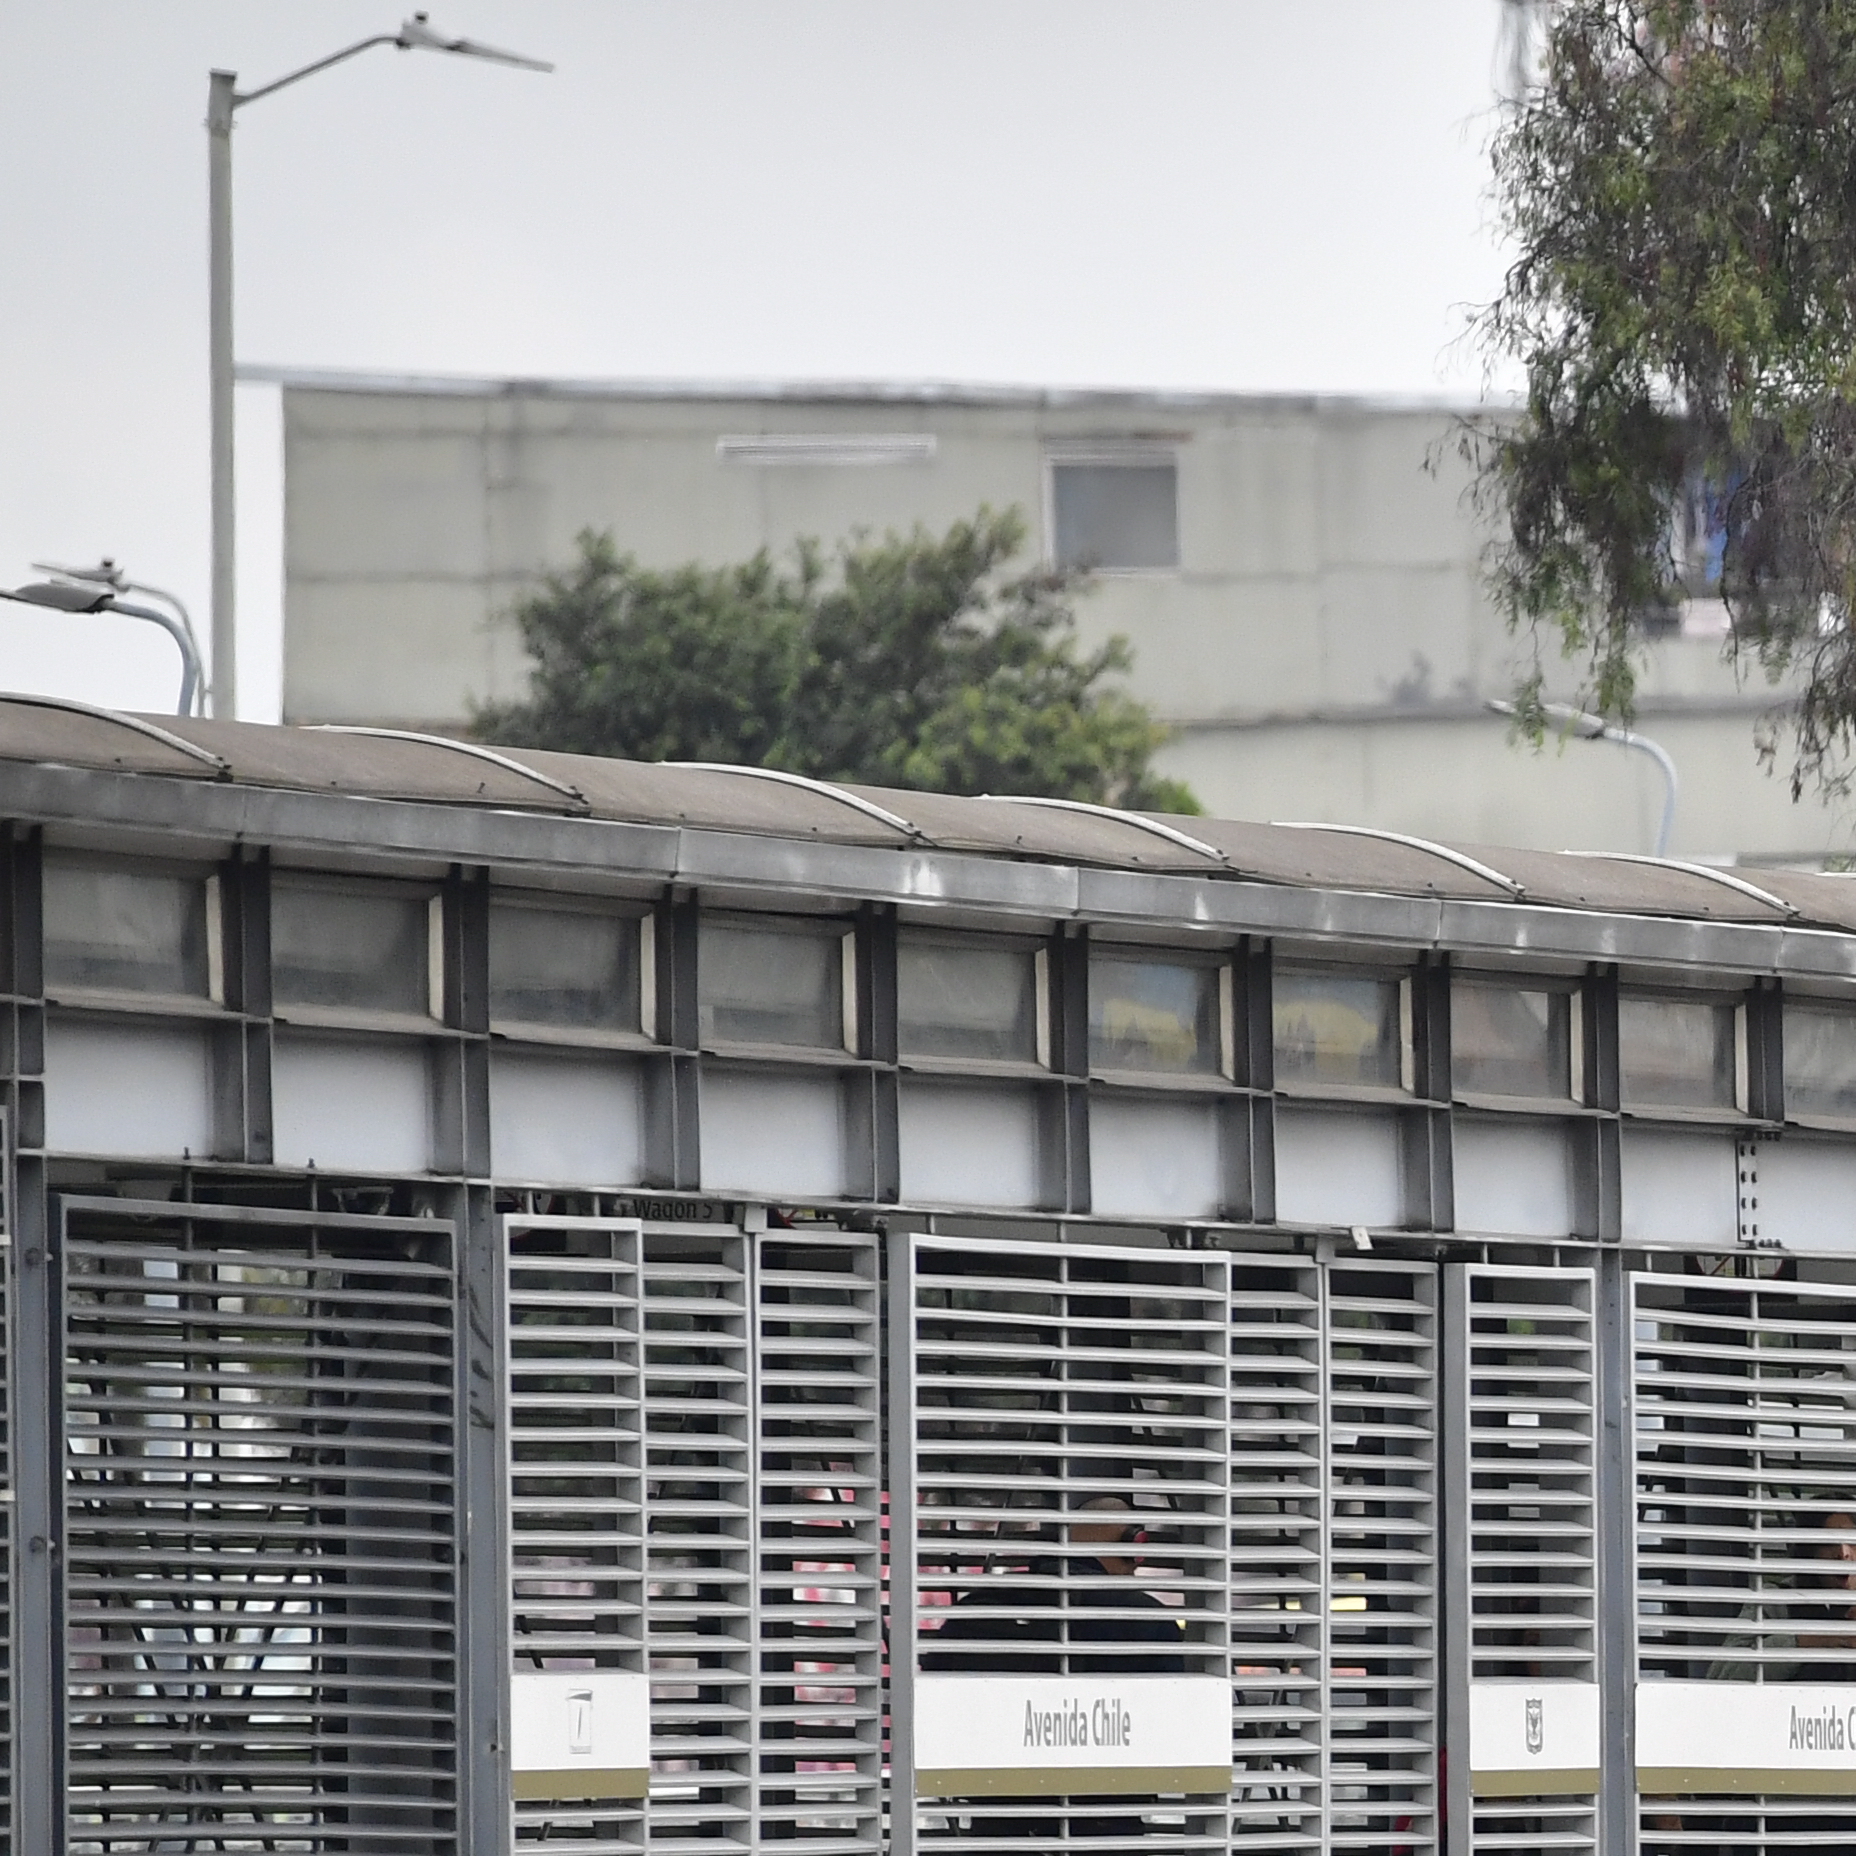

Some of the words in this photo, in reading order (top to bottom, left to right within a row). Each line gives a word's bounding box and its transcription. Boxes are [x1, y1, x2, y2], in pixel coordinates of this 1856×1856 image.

[1023, 1697, 1088, 1747] Avenida
[1092, 1697, 1131, 1747] Chile
[1789, 1705, 1845, 1750] Avenida
